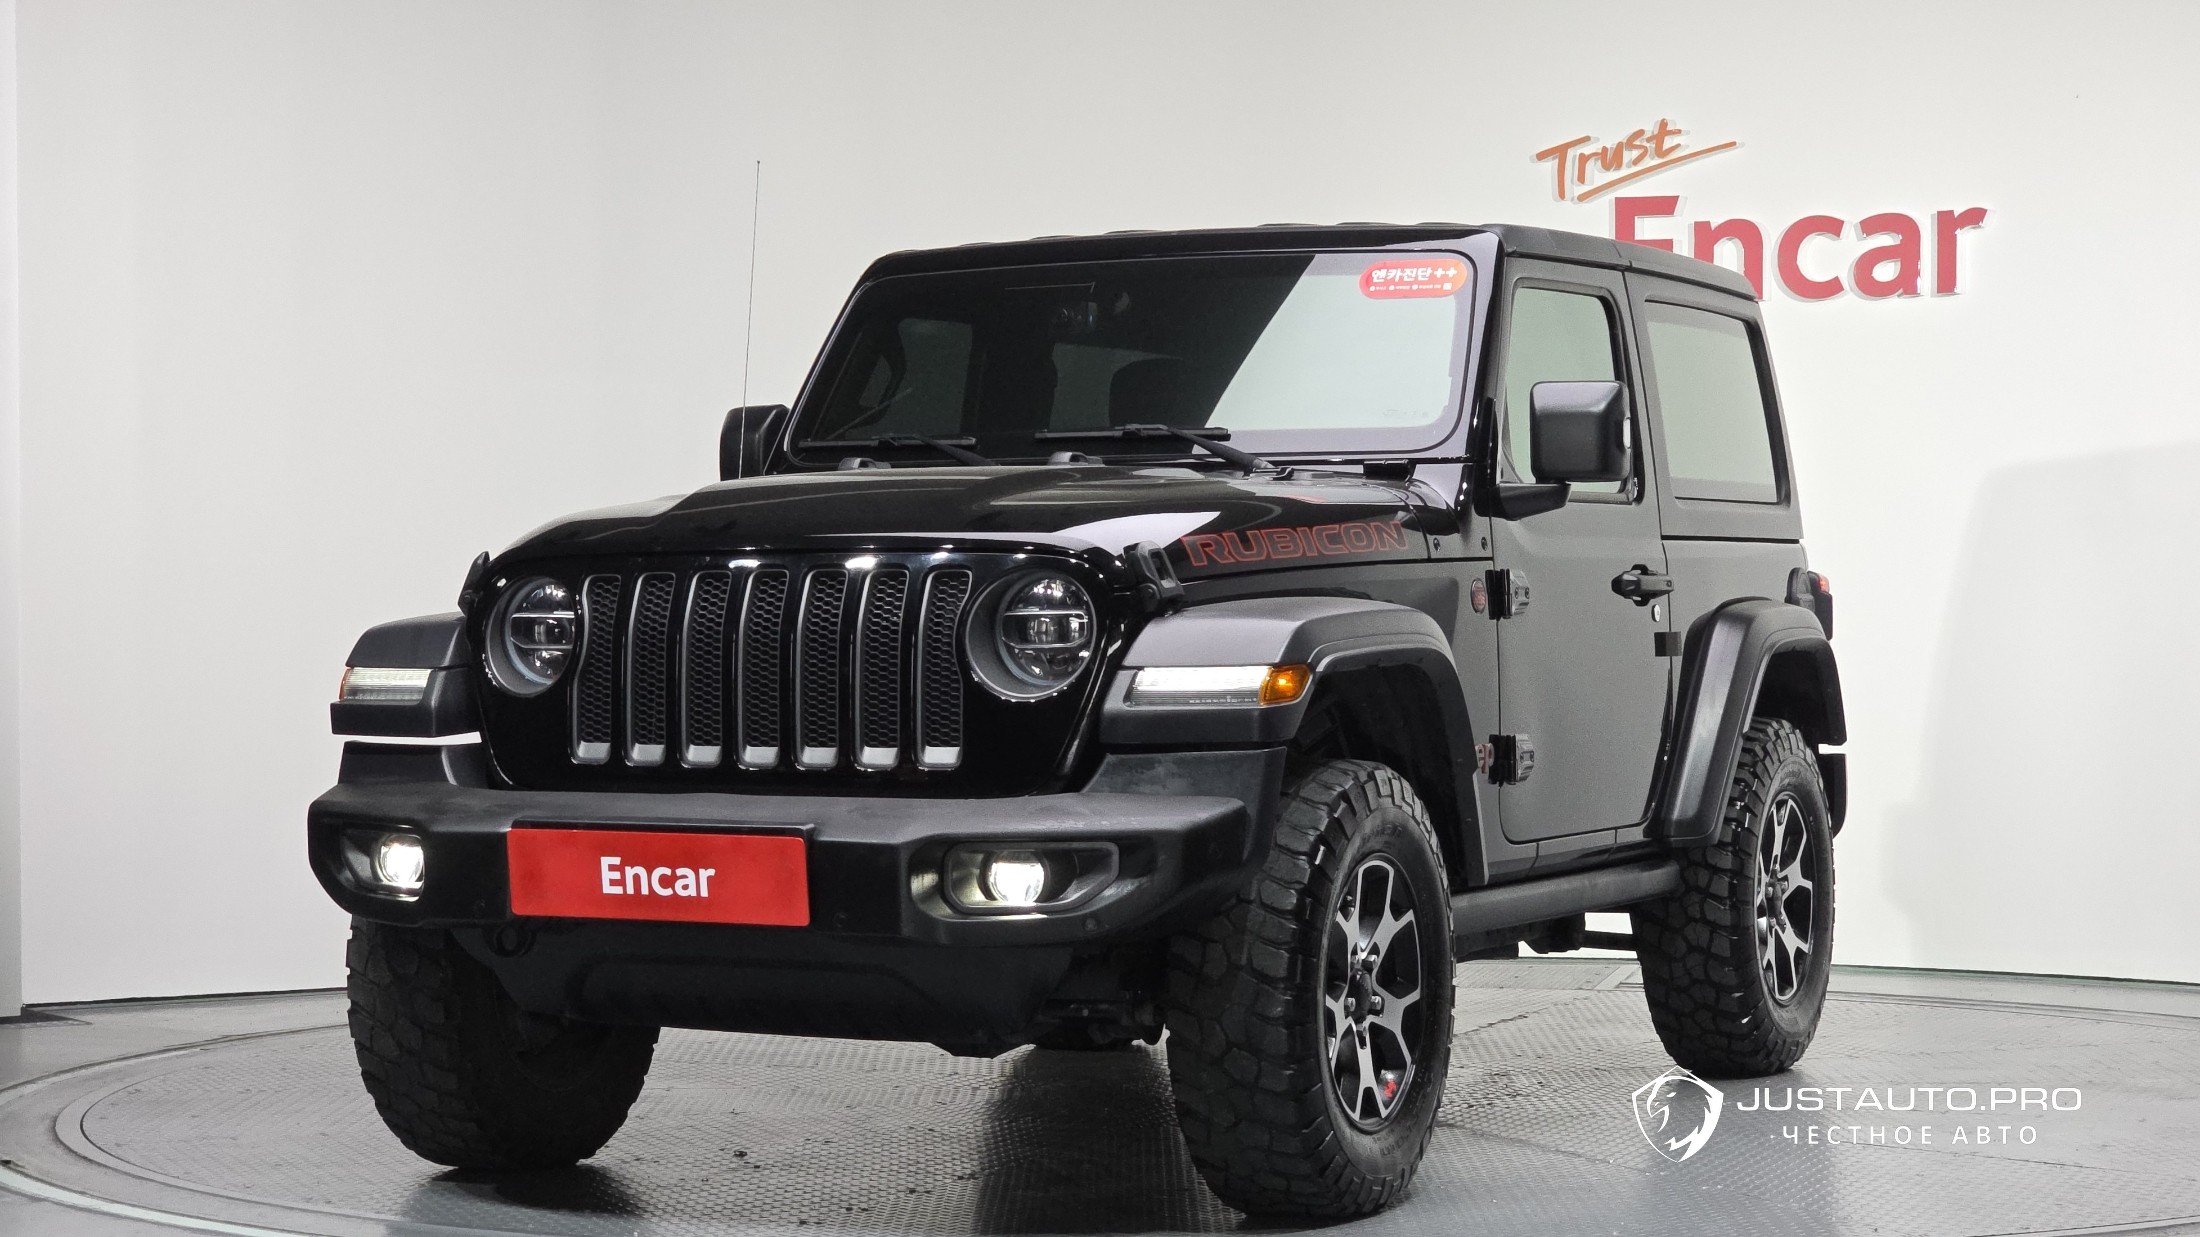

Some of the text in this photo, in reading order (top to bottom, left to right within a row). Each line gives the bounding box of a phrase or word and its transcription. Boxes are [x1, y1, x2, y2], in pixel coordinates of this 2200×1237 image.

[1535, 118, 1682, 201] Trust
[1180, 521, 1408, 566] RUBICON
[600, 856, 715, 898] Encar
